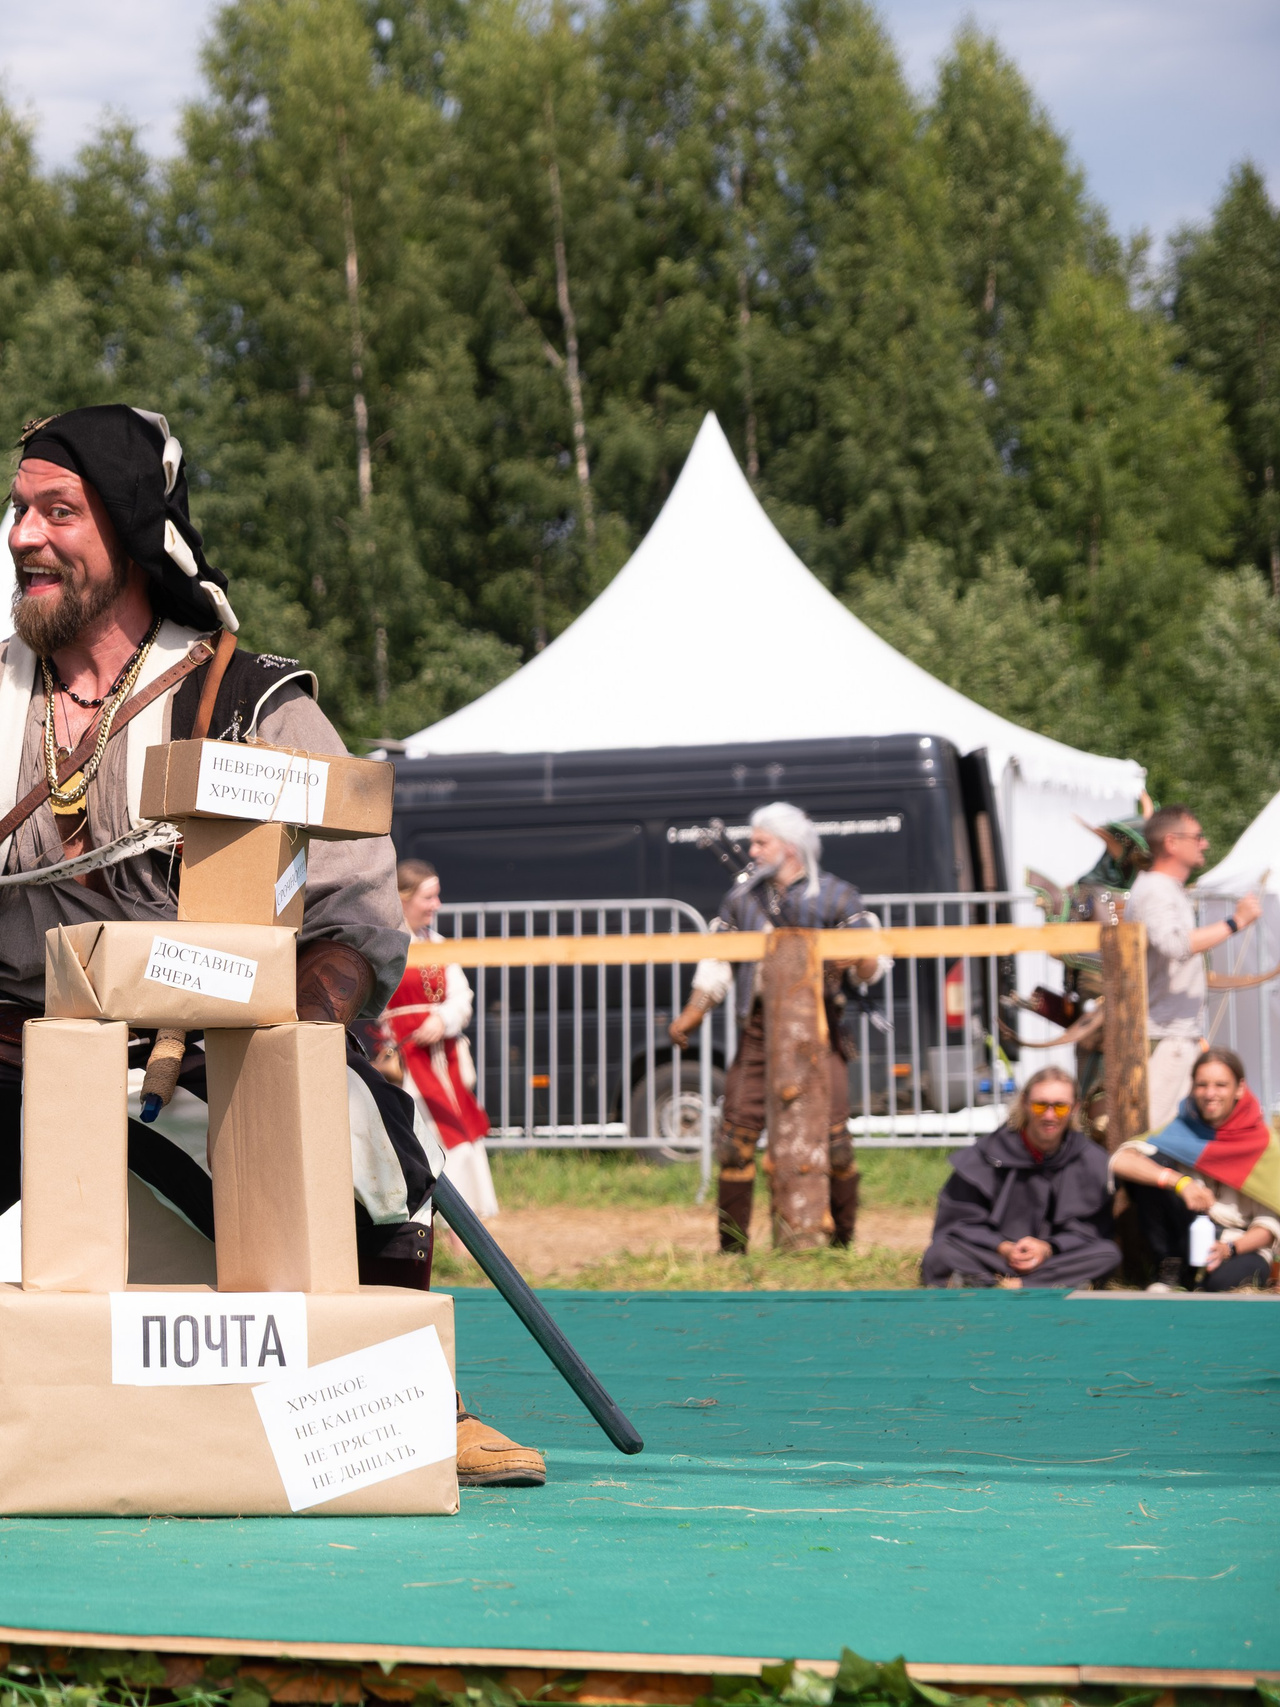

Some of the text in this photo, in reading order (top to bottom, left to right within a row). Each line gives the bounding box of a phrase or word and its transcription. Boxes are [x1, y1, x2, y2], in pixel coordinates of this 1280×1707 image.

[212, 756, 320, 787] НЕВЕРОЯТНО
[208, 783, 276, 807] ХРУПКО
[149, 964, 203, 991] ВЧЕРА
[154, 941, 255, 979] ДОСТАВИТЬ
[141, 1313, 288, 1369] ПОЧТА
[285, 1375, 369, 1414] ХРУПКОЕ
[294, 1385, 426, 1440] НЕ КАНТОВАТЬ
[303, 1447, 329, 1467] НЕ
[311, 1444, 417, 1490] НЕ ДЫШАТЬ
